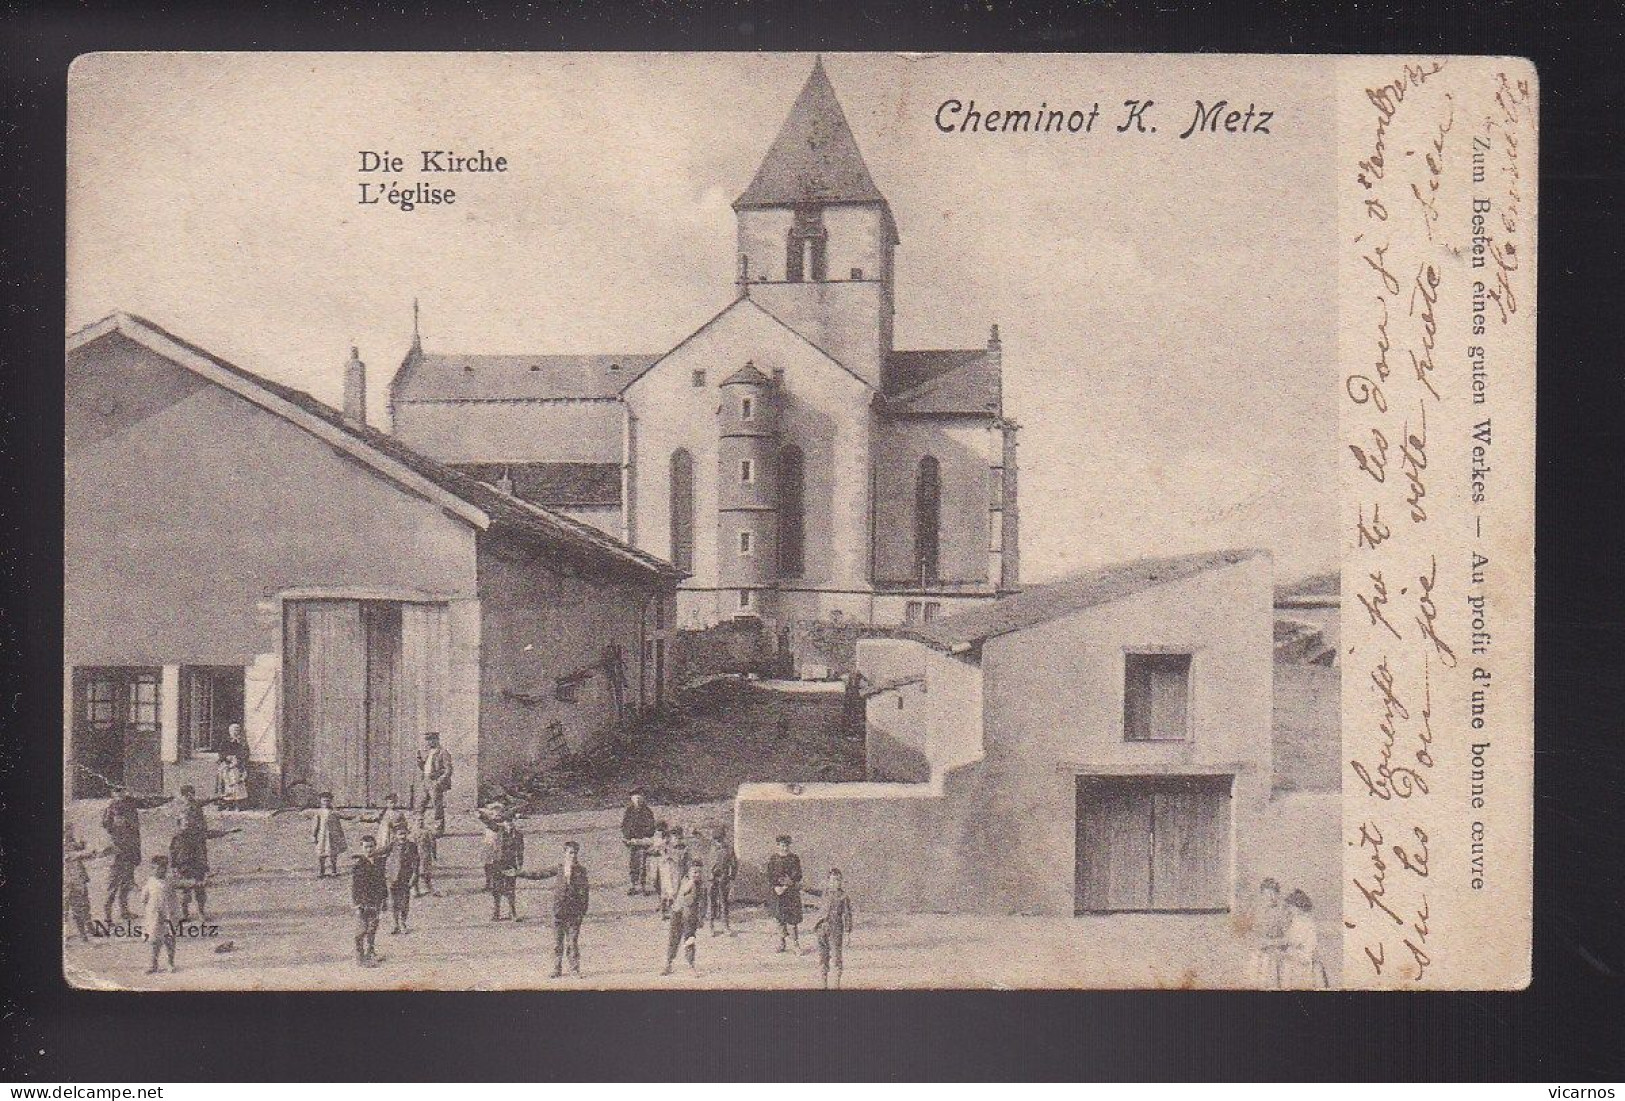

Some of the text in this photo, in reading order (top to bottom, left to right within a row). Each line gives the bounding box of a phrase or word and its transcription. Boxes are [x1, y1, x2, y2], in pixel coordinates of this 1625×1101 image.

[934, 99, 1274, 139] Cheminot K. Metz
[358, 150, 508, 173] Die Kirche
[1471, 135, 1490, 184] Zum
[358, 181, 456, 212] L'église
[1471, 197, 1490, 269] Besten
[1471, 281, 1490, 335] eines
[1466, 345, 1489, 406] guten
[1471, 418, 1490, 503] Werkes
[1470, 551, 1489, 585] Au
[1465, 595, 1489, 656] profit
[1470, 666, 1490, 729] d'une
[1470, 742, 1489, 809] bonne
[1470, 820, 1485, 890] œuvre
[91, 919, 219, 943] Nels, Metz
